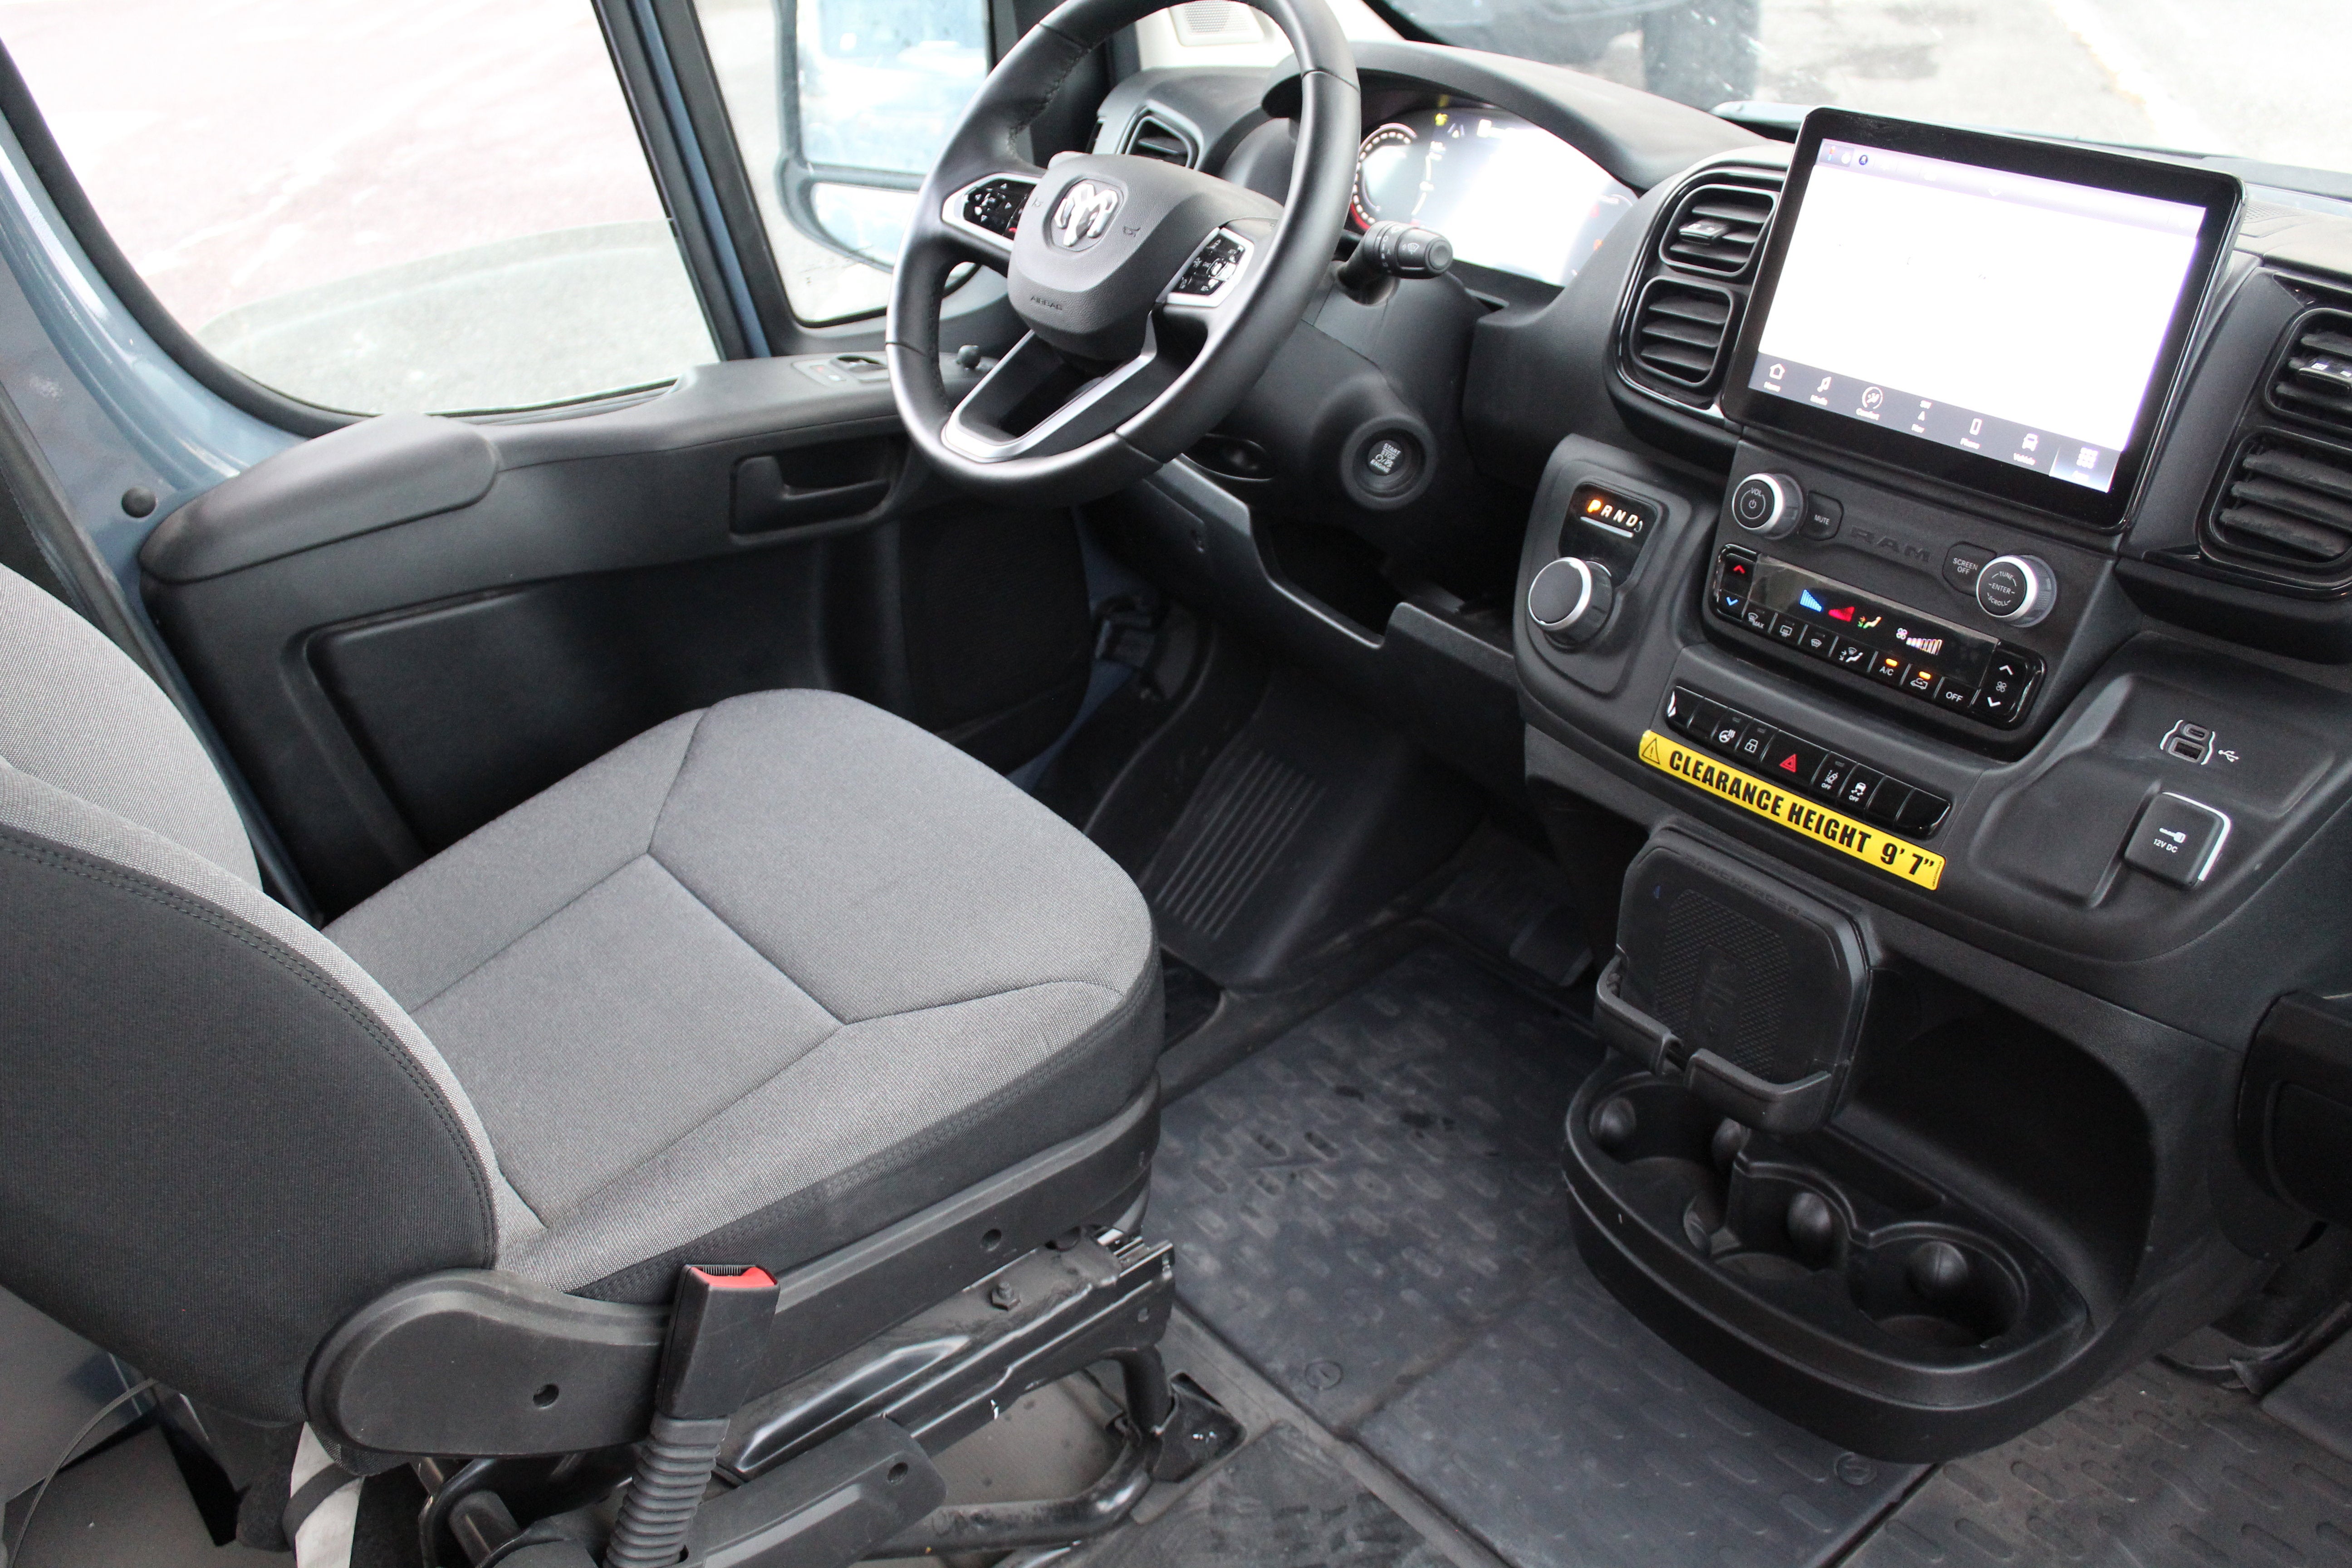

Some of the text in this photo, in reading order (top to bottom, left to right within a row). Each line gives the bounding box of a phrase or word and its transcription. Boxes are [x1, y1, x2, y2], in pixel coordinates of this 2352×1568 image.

[1381, 450, 1396, 460] STOP
[1383, 443, 1401, 455] START
[1370, 459, 1391, 473] ENGINE
[1750, 487, 1762, 496] VOL
[1587, 499, 1638, 527] P R N D
[1814, 514, 1830, 525] MUTE
[1851, 525, 1930, 562] RAM
[1953, 558, 1978, 570] SCREEN
[1957, 566, 1970, 575] OFF
[1999, 571, 2014, 581] TUNE
[1987, 595, 2008, 607] SCROLL
[1879, 666, 1894, 676] A/C
[1945, 691, 1963, 702] OFF
[1670, 750, 1784, 817] CLEARANCE
[1787, 802, 1872, 853] HEIGHT
[2153, 838, 2178, 853] 12V DC
